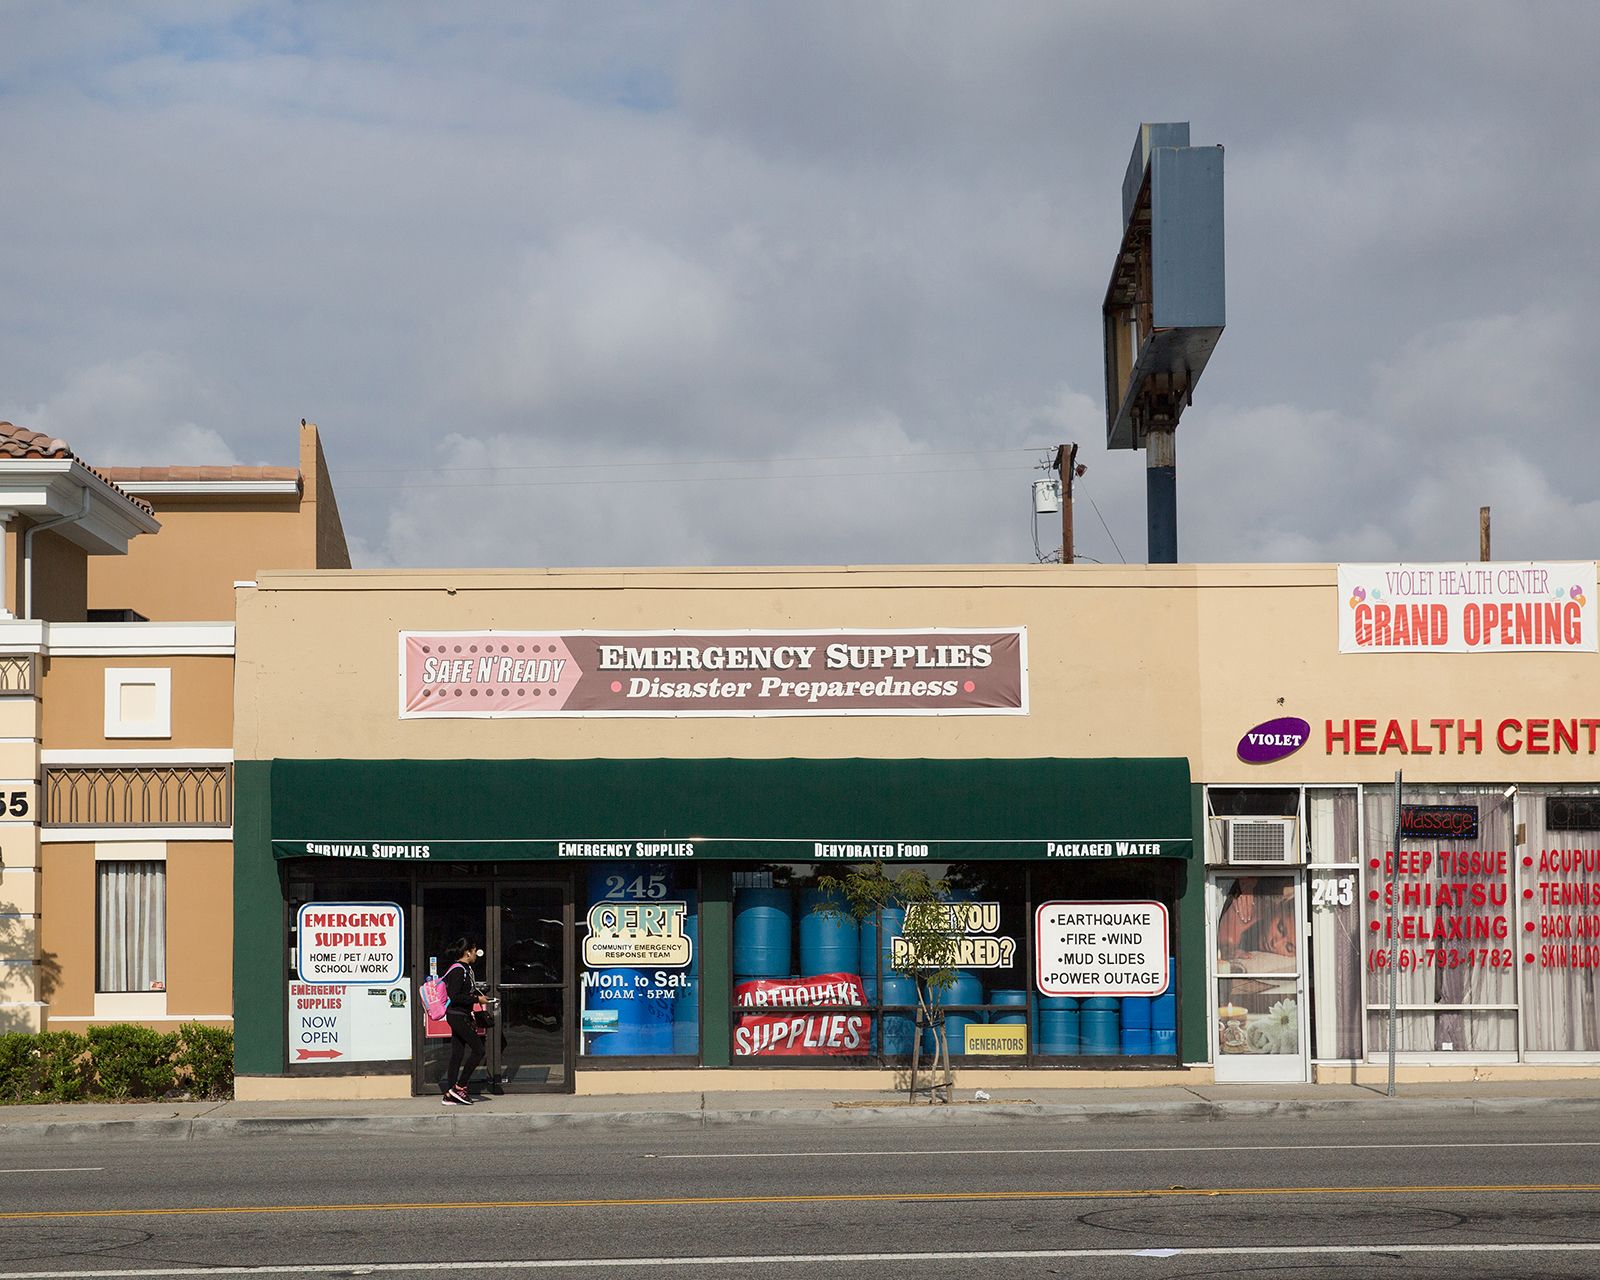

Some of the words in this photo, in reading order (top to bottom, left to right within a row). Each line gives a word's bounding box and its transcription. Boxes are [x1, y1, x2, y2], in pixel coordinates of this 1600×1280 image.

[1385, 570, 1434, 596] VIOLET
[1438, 569, 1492, 595] HEALTH
[1497, 569, 1549, 594] CENTER
[1355, 603, 1448, 646] GRAND
[1463, 601, 1582, 646] OPENING
[598, 644, 816, 671] EMERGENCY
[825, 643, 994, 668] SUPPLIES
[422, 655, 473, 684] SAFE
[626, 676, 752, 700] Disaster
[758, 676, 958, 702] Preparedness
[1247, 732, 1302, 747] VIOLET
[1325, 719, 1483, 754] HEALTH
[1496, 718, 1600, 754] CENT
[1401, 808, 1473, 834] Massage
[306, 843, 368, 857] SURVIVAL
[372, 843, 430, 858] SUPPLIES
[558, 842, 632, 857] EMERGENCY
[636, 842, 694, 857] SUPPLIES
[814, 843, 894, 858] DEHYDRATED
[897, 843, 928, 857] FOOD
[1047, 842, 1112, 857] PACKAGED
[1115, 842, 1160, 856] WATER
[1440, 851, 1507, 875] TISSUE
[1539, 849, 1600, 872] ACUPU
[605, 875, 667, 898] 245
[1311, 879, 1353, 905] 243
[1385, 882, 1507, 906] SHIATSU
[1539, 882, 1600, 905] TENNIS
[304, 913, 396, 928] EMERGENCY
[590, 903, 684, 937] CERT
[1057, 913, 1151, 926] EARTHQUAKE
[1541, 915, 1572, 938] BACK
[1577, 915, 1600, 938] AND
[315, 932, 387, 947] SUPPLIES
[1066, 933, 1096, 945] FIRE
[1107, 933, 1142, 945] WIND
[310, 953, 337, 963] HOME
[343, 953, 361, 963] PET
[367, 953, 394, 963] AUTO
[1064, 953, 1094, 965] MUD
[1098, 953, 1145, 965] SLIDES
[1541, 944, 1567, 968] SKIN
[1571, 944, 1600, 968] BLOO
[314, 964, 353, 974] SCHOOL
[360, 964, 388, 973] WORK
[584, 971, 629, 987] Mon.
[634, 975, 649, 987] to
[654, 971, 692, 987] Sat.
[1050, 973, 1100, 985] POWER
[1104, 973, 1160, 985] OUTAGE
[291, 984, 347, 995] EMERGENCY
[600, 989, 634, 999] 10AM
[647, 989, 675, 999] 5PM
[297, 998, 342, 1009] SUPPLIES
[302, 1016, 337, 1028] NOW
[301, 1031, 338, 1043] OPEN
[736, 1015, 863, 1055] SUPPLIES
[969, 1038, 1024, 1051] GENERATORS
